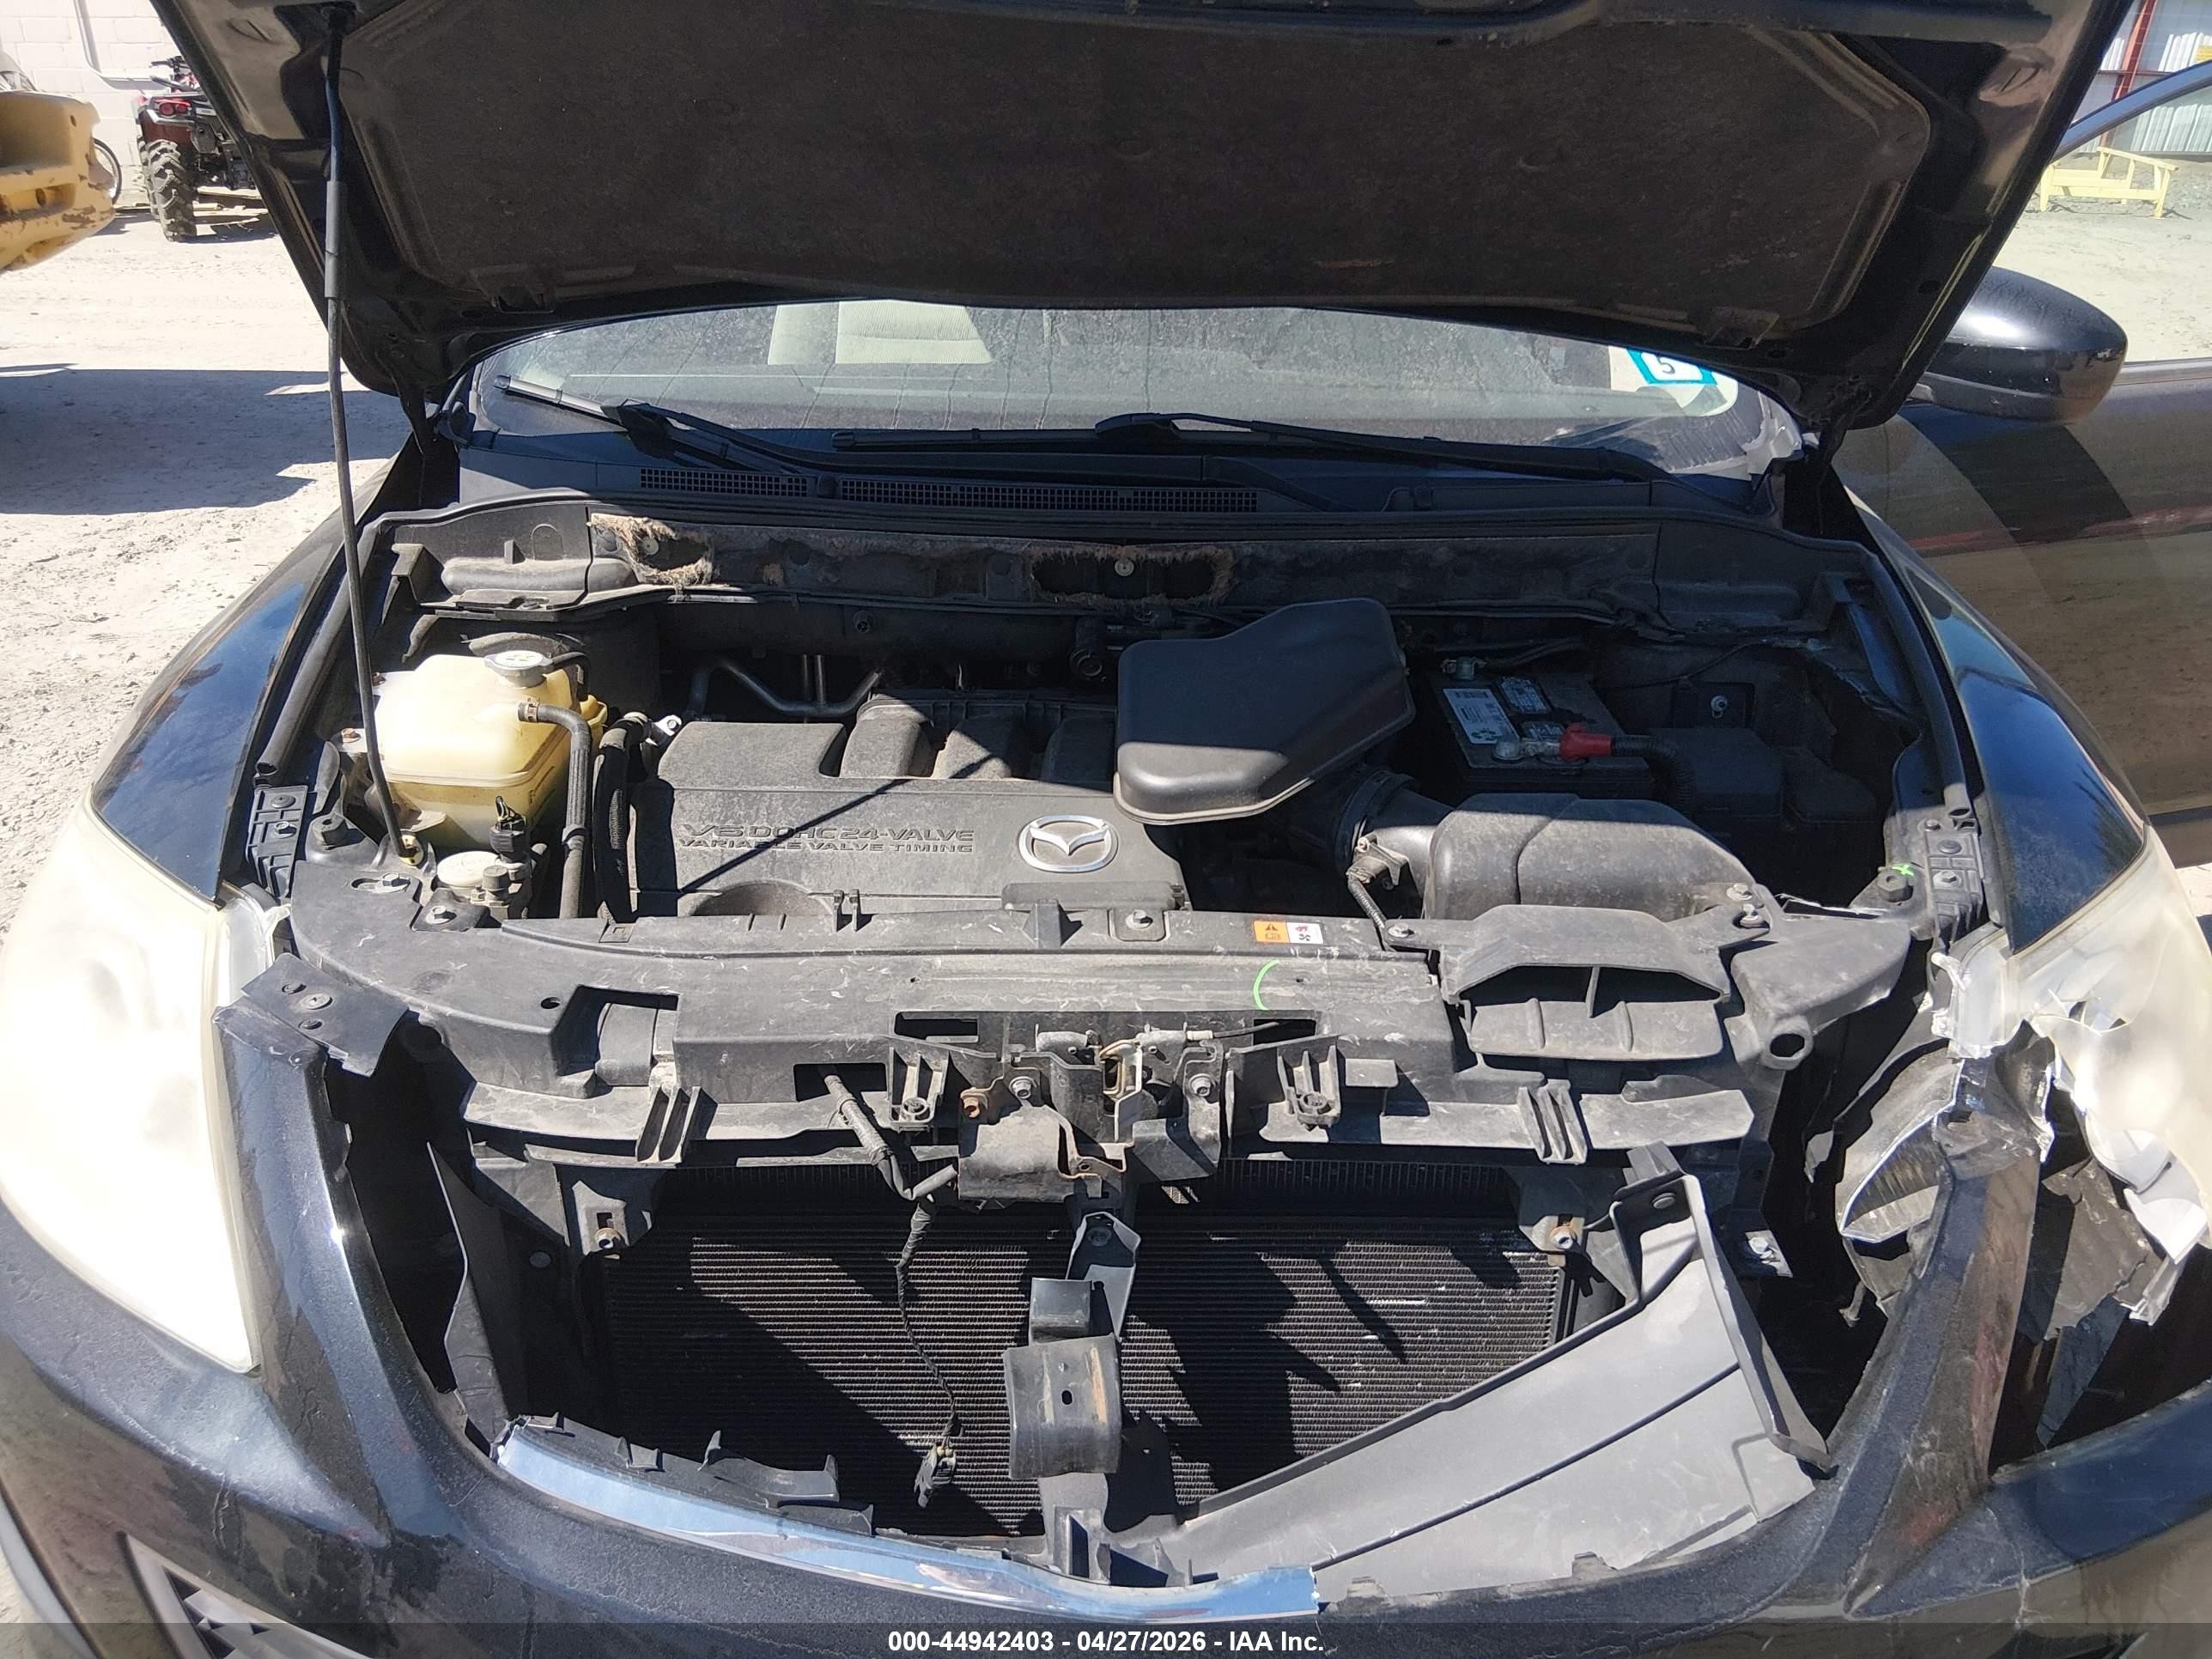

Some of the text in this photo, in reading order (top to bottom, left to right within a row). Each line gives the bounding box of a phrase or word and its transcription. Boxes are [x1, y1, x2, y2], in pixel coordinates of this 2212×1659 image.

[681, 824, 975, 842] V6 DOHC 24-VALVE
[680, 839, 973, 853] VARIABLE VALVE TIMING
